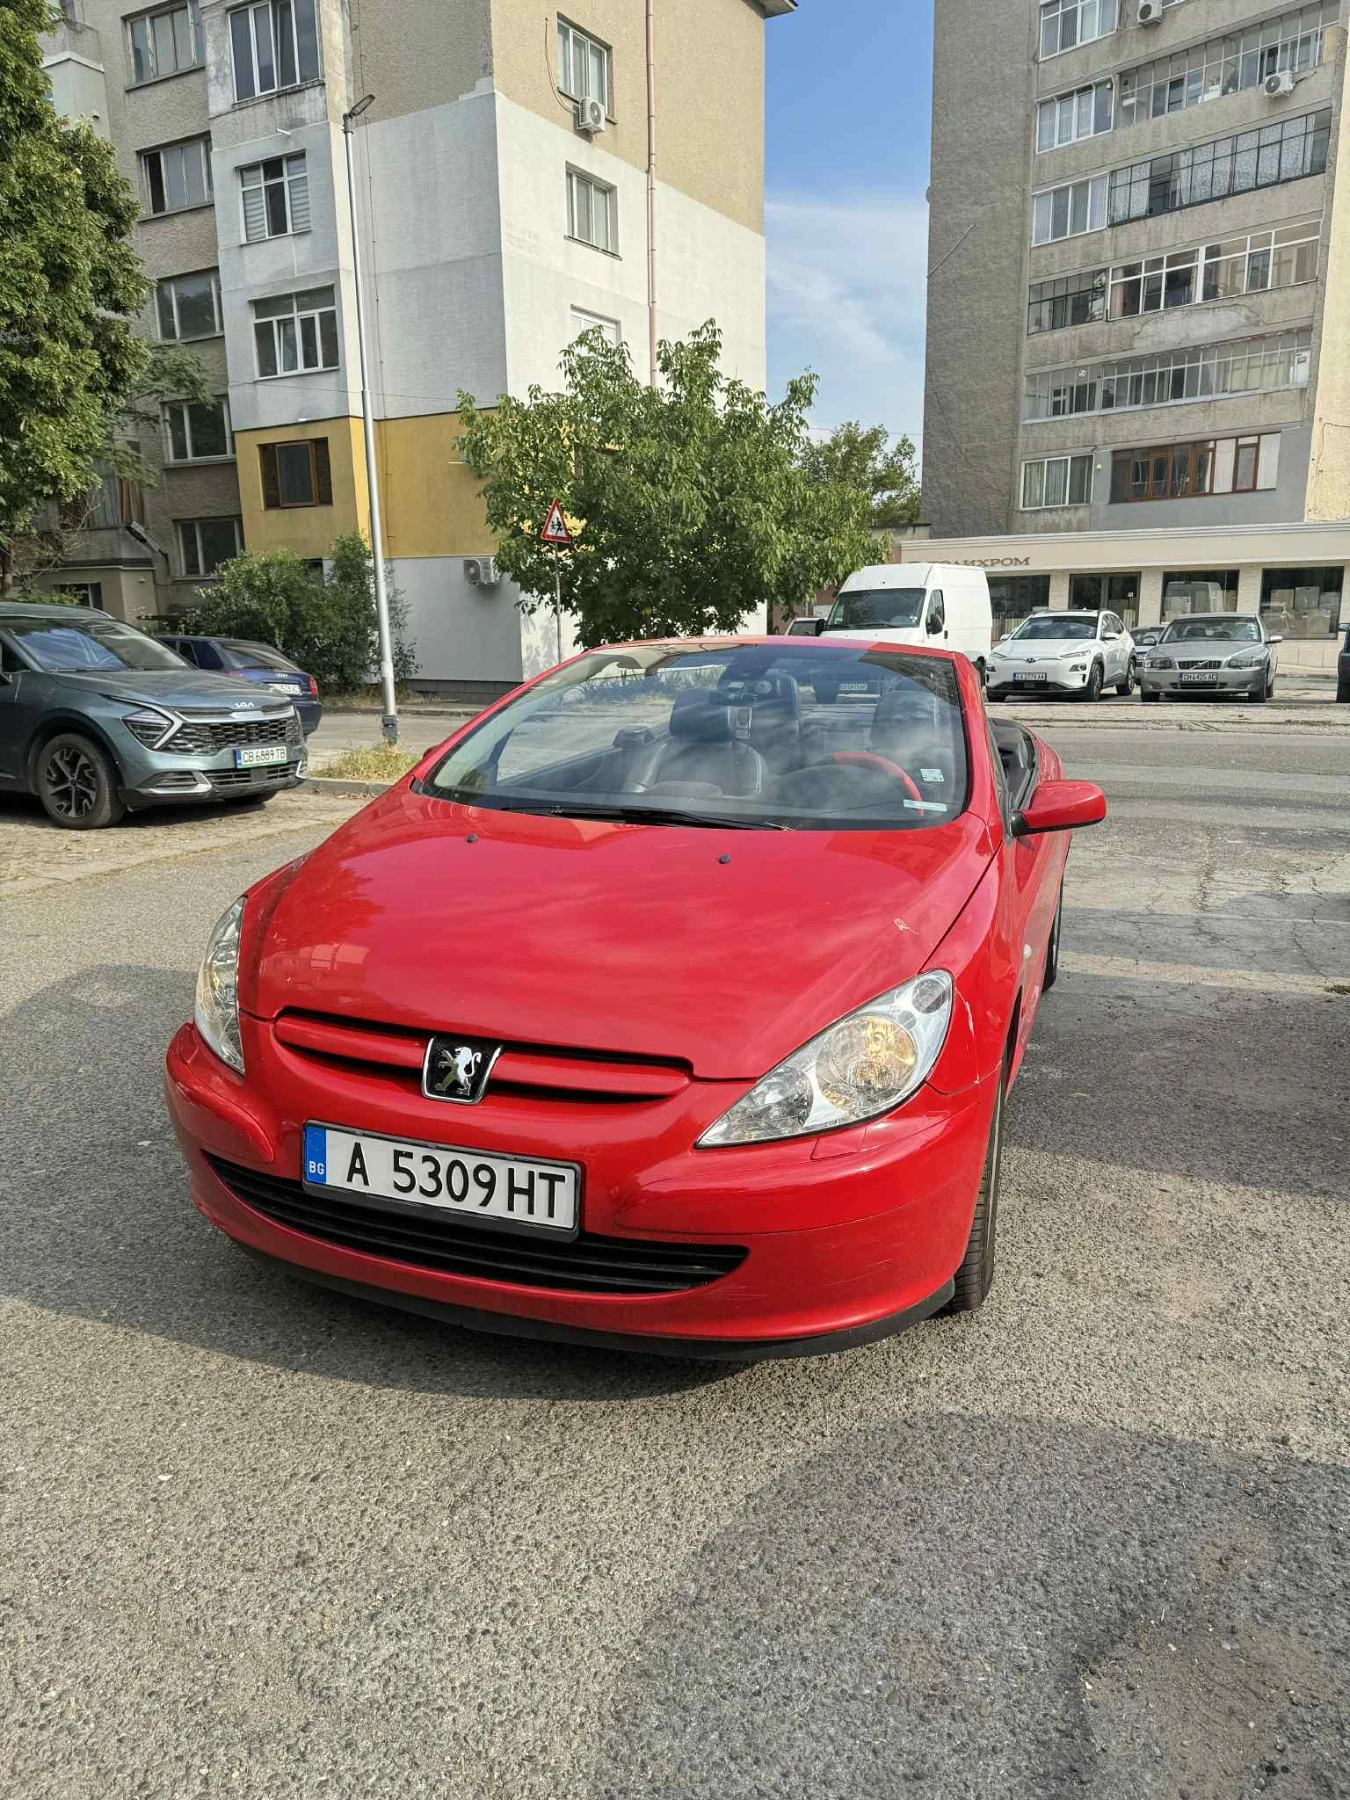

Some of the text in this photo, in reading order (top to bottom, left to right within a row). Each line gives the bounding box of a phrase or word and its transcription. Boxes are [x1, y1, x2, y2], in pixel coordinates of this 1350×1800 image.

[927, 557, 1031, 568] ЛИХРОМ
[243, 751, 254, 763] CB
[275, 748, 286, 760] TB
[309, 1161, 325, 1175] BG
[346, 1142, 566, 1218] A 5309 HT
